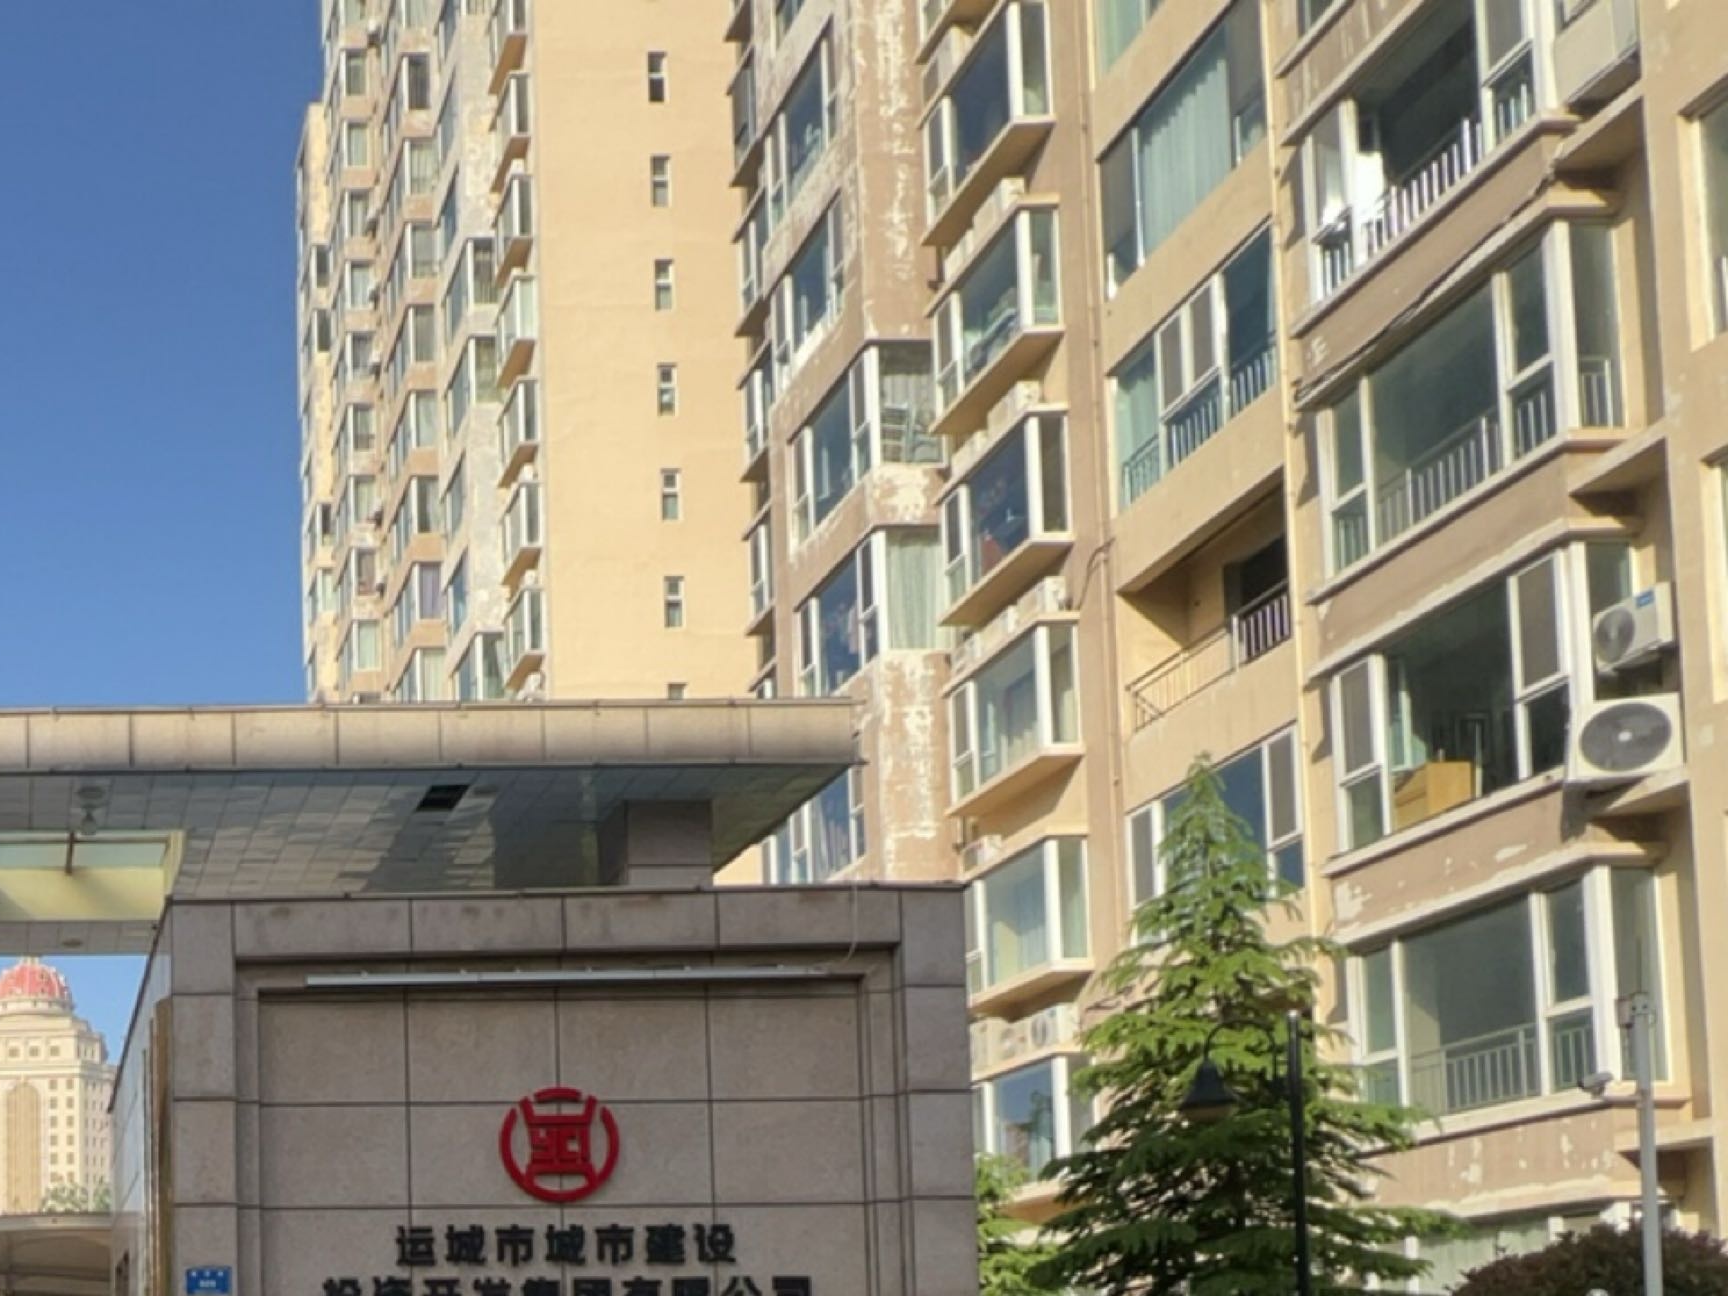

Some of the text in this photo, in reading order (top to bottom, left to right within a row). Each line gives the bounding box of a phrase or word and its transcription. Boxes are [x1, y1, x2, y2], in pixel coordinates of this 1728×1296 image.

[395, 1223, 738, 1267] 运城市城市建设
